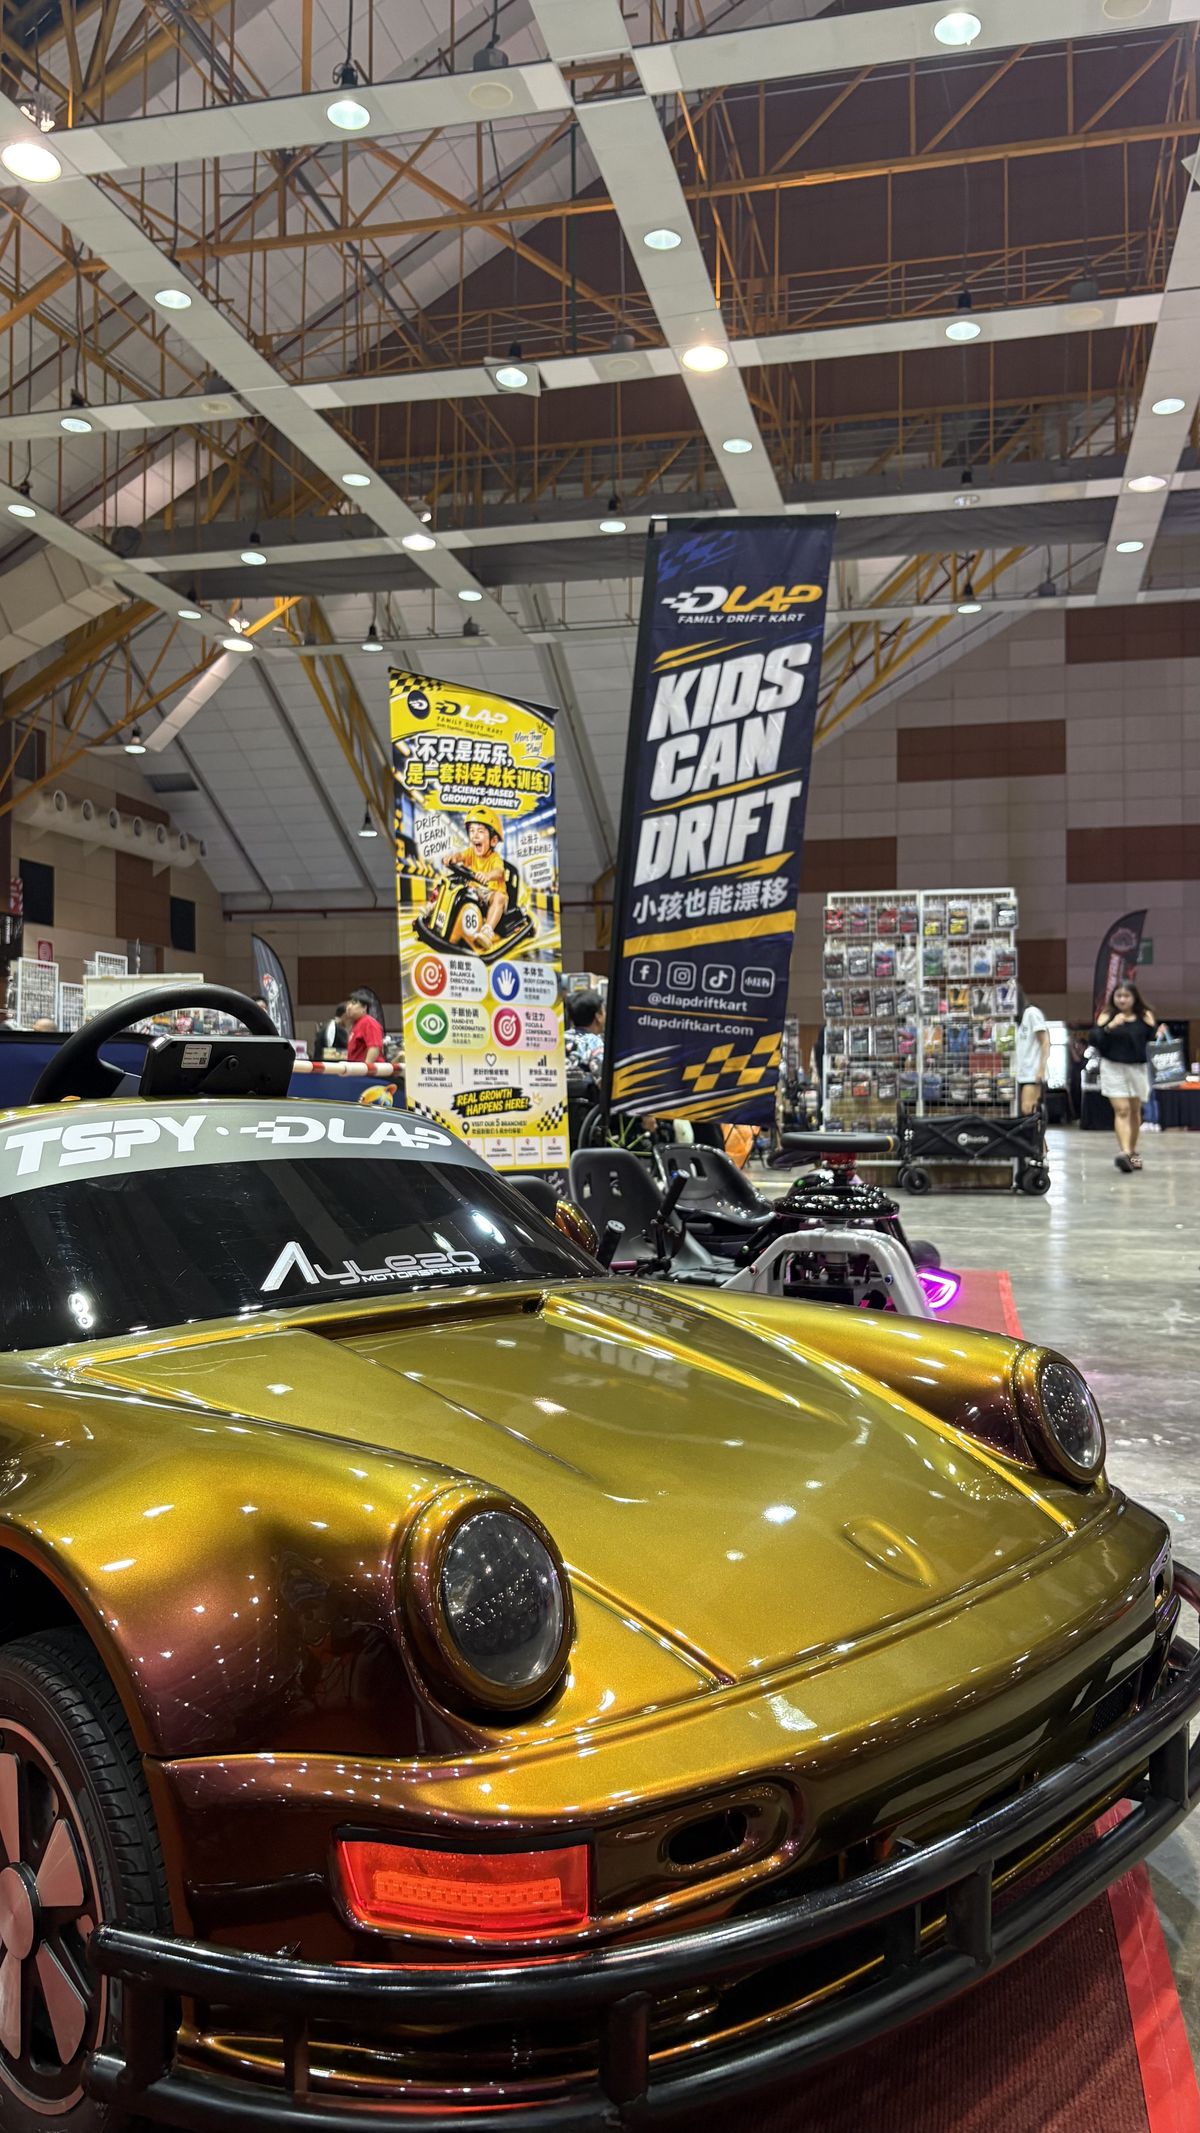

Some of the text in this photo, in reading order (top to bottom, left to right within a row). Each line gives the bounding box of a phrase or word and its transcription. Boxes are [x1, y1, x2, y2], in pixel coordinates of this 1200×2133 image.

[661, 584, 823, 613] DLAP
[678, 613, 805, 624] FAMILY DRIFT KART
[647, 643, 812, 741] KIDS
[650, 711, 787, 801] CAN
[442, 794, 520, 808] GROWTH JOURNEY
[452, 785, 514, 798] SCIENCE-BASED
[415, 814, 441, 831] DRIFT
[420, 827, 446, 844] LEARN
[633, 780, 802, 887] DRIFT
[424, 837, 451, 857] GROW!
[632, 877, 789, 924] 小孩也能漂移
[465, 914, 478, 929] 86
[648, 992, 748, 1012] @dlapdriftkart
[637, 1014, 754, 1037] dlapdriftkart.com
[456, 1088, 513, 1106] REAL GROWTH
[465, 1098, 529, 1116] HAPPENS HERE!
[4, 1114, 206, 1176] TSPY
[361, 1266, 482, 1282] MOTORSPORTS
